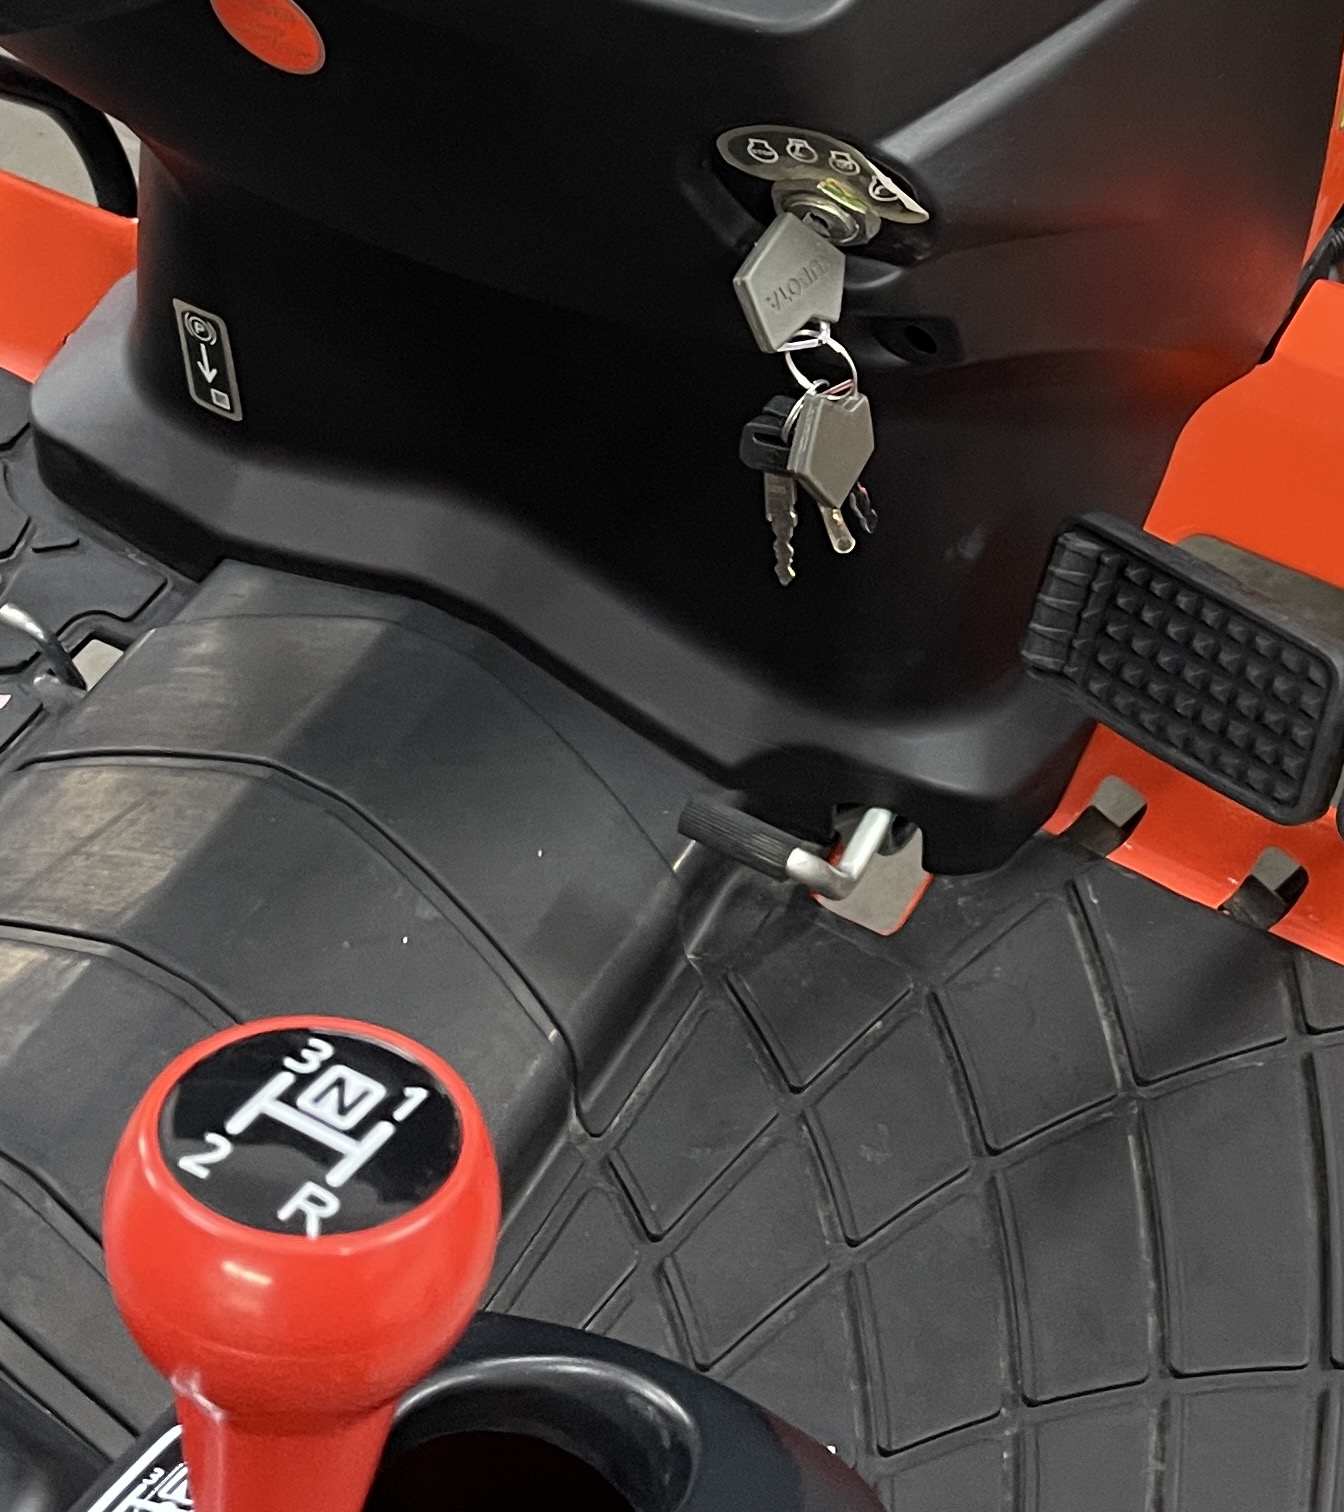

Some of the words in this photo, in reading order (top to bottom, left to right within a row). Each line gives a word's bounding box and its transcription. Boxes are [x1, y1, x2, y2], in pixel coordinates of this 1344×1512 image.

[282, 1037, 335, 1075] 3
[311, 1076, 370, 1116] N
[392, 1086, 429, 1122] 1
[178, 1131, 233, 1179] 2
[276, 1180, 341, 1240] R
